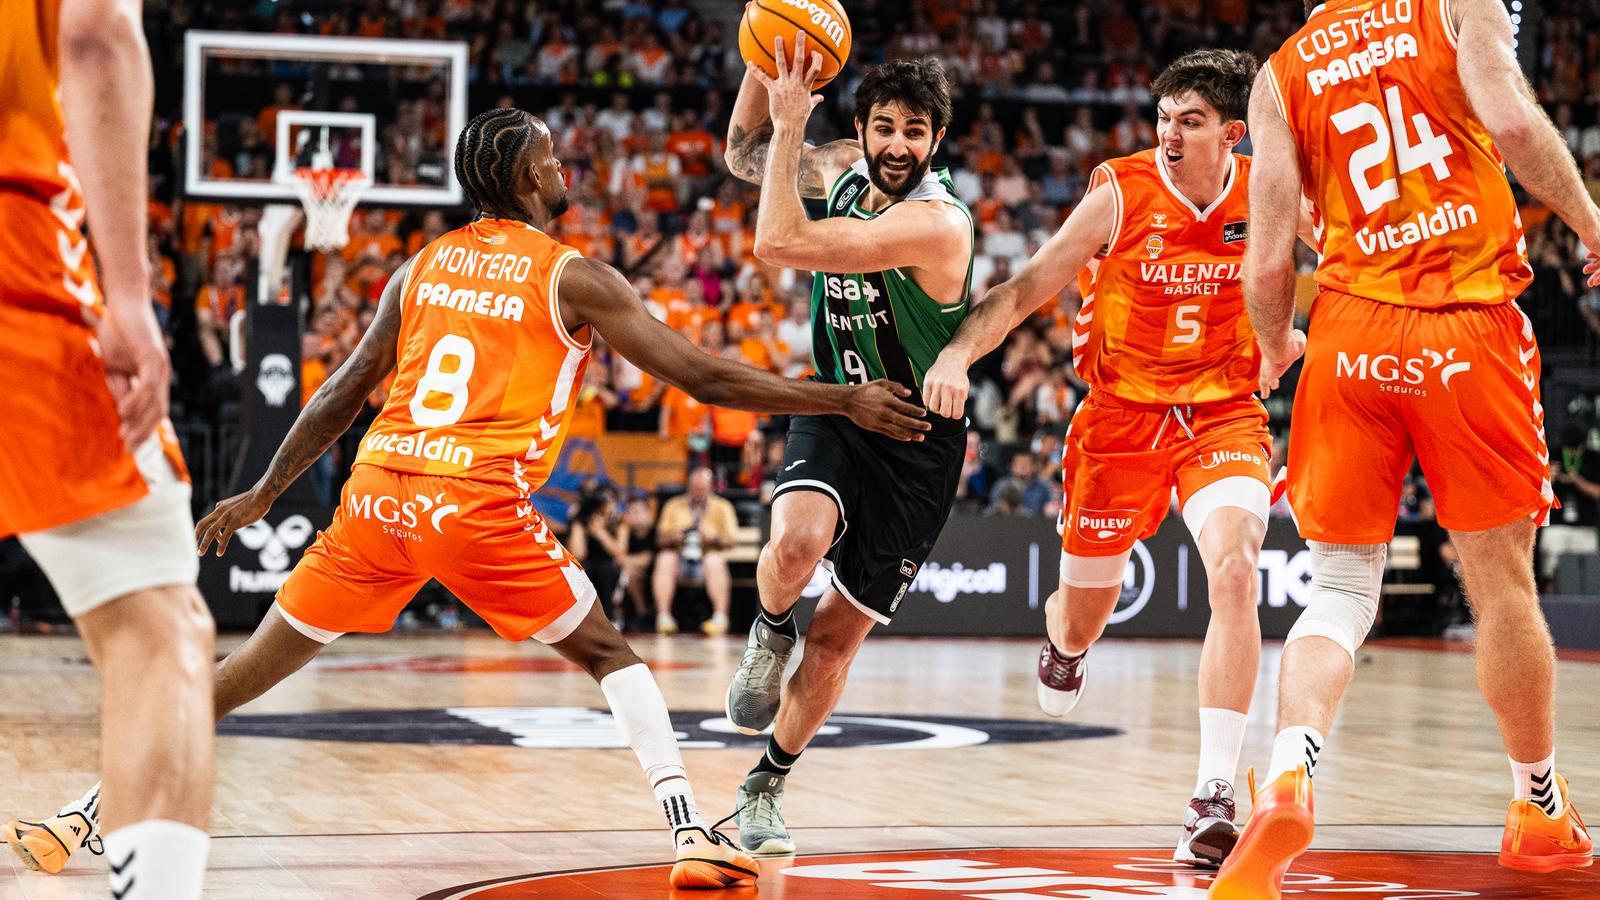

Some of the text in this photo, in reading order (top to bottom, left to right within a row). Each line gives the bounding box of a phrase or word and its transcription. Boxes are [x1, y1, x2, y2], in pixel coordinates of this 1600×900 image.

[1296, 0, 1412, 62] COSTELLO
[1306, 33, 1418, 96] PAMESA
[1329, 85, 1453, 215] 24
[430, 245, 532, 283] MONTERO
[415, 282, 525, 322] PAMESA
[1163, 282, 1221, 295] BASKET
[826, 306, 889, 331] ENTUT
[1171, 305, 1201, 343] 5
[409, 333, 476, 428] 8
[843, 350, 868, 385] 9
[1335, 351, 1425, 385] MGS
[1379, 383, 1428, 398] Seguros
[366, 431, 474, 467] vitaldin
[1198, 450, 1261, 469] Midea
[349, 493, 417, 528] MGS
[382, 524, 423, 542] Seguros
